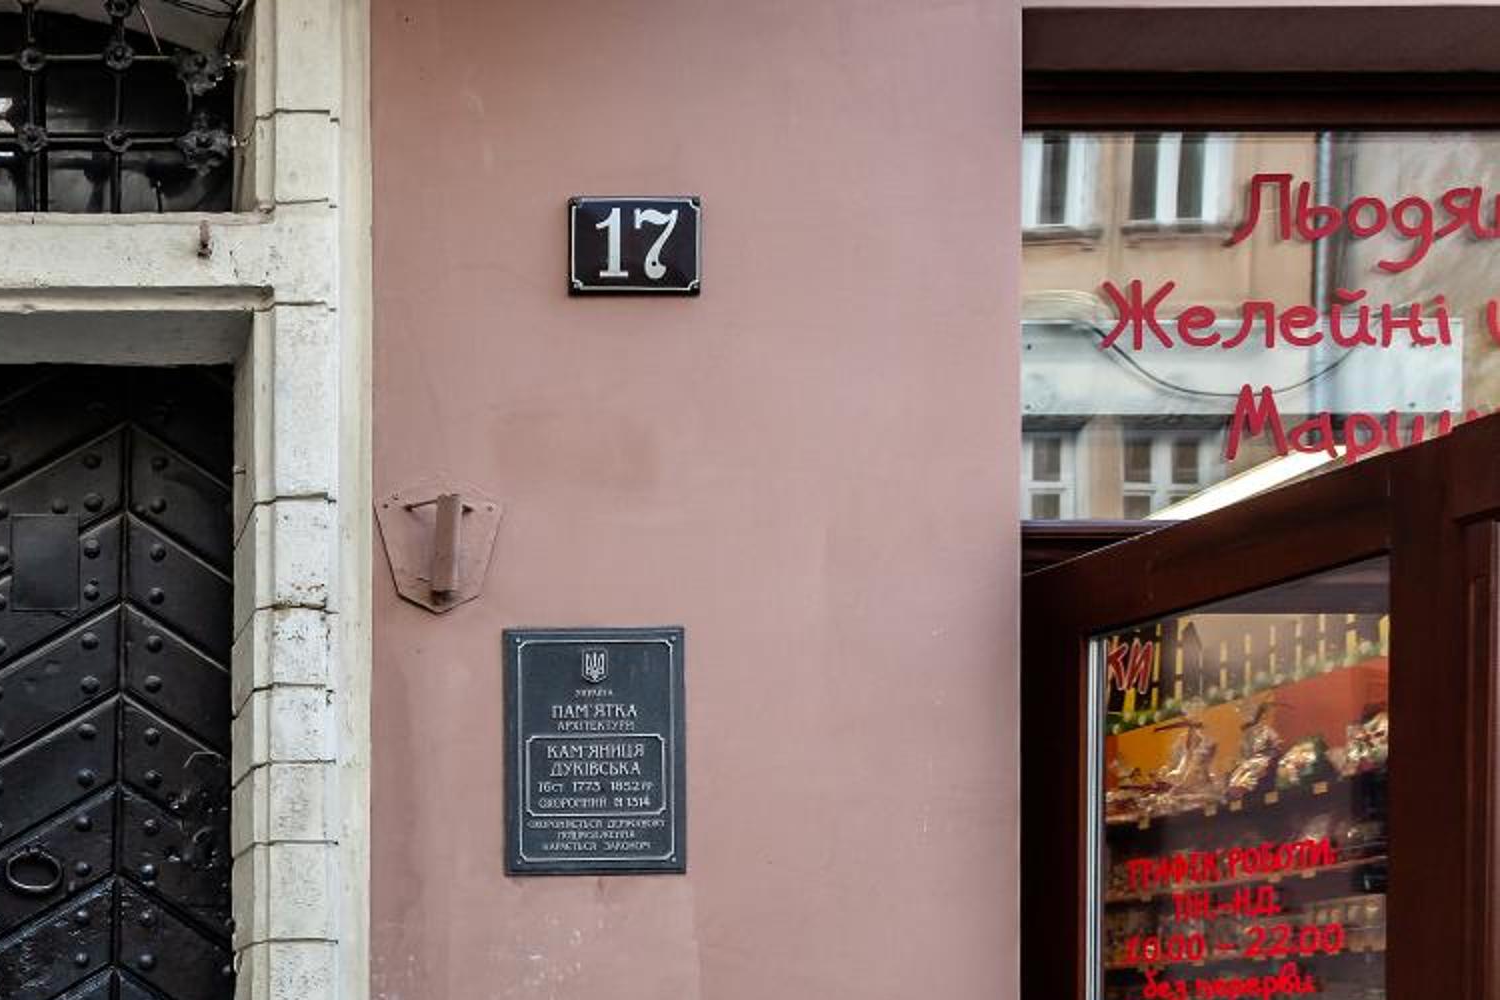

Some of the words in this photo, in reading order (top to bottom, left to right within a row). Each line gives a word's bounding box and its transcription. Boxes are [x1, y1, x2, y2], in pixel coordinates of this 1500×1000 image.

[595, 207, 679, 279] 17
[1222, 173, 1500, 273] Льодя
[1099, 279, 1453, 349] Желейні
[547, 743, 645, 759] КАМ'ЯНИЦЯ
[549, 761, 641, 777] ДУКІВСЬКА
